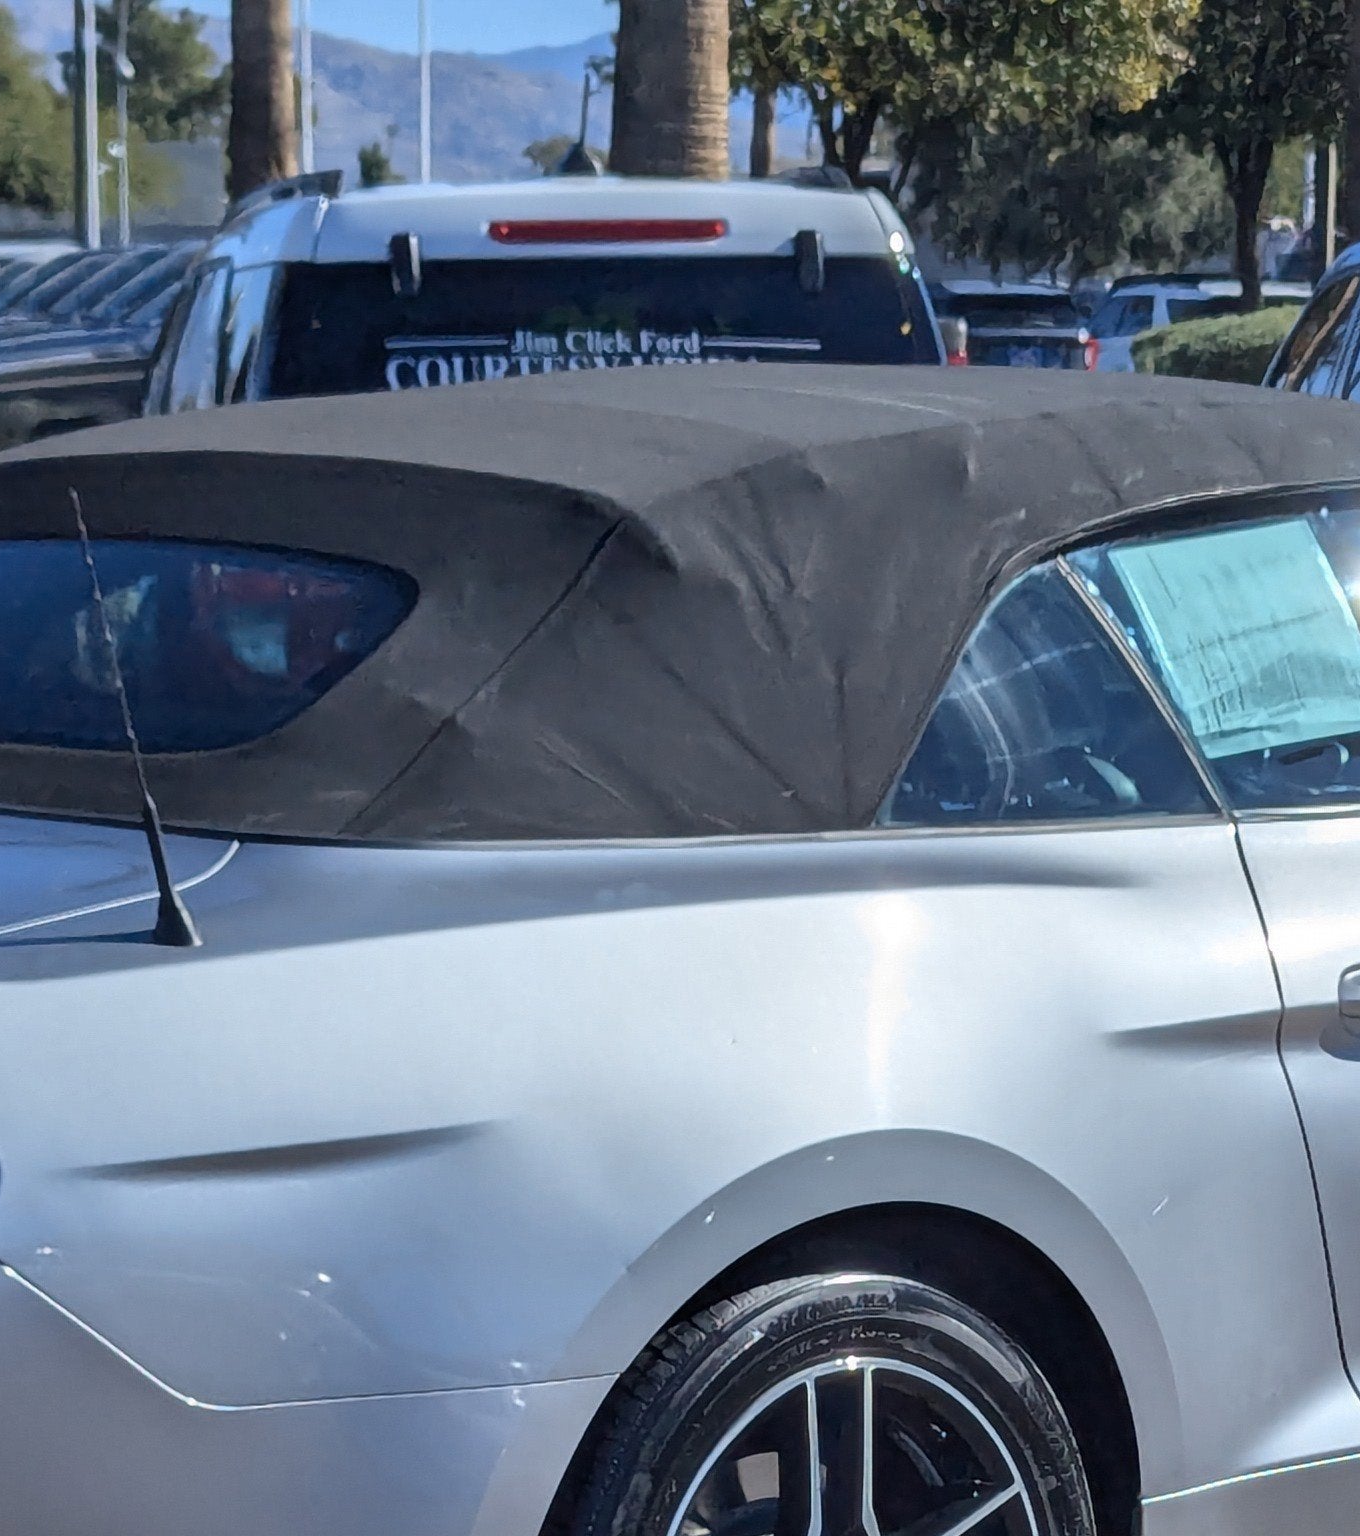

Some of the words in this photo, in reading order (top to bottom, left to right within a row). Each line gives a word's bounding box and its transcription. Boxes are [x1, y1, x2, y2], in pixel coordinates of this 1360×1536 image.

[511, 329, 558, 354] Jim
[565, 329, 632, 354] Click
[640, 329, 700, 354] Ford
